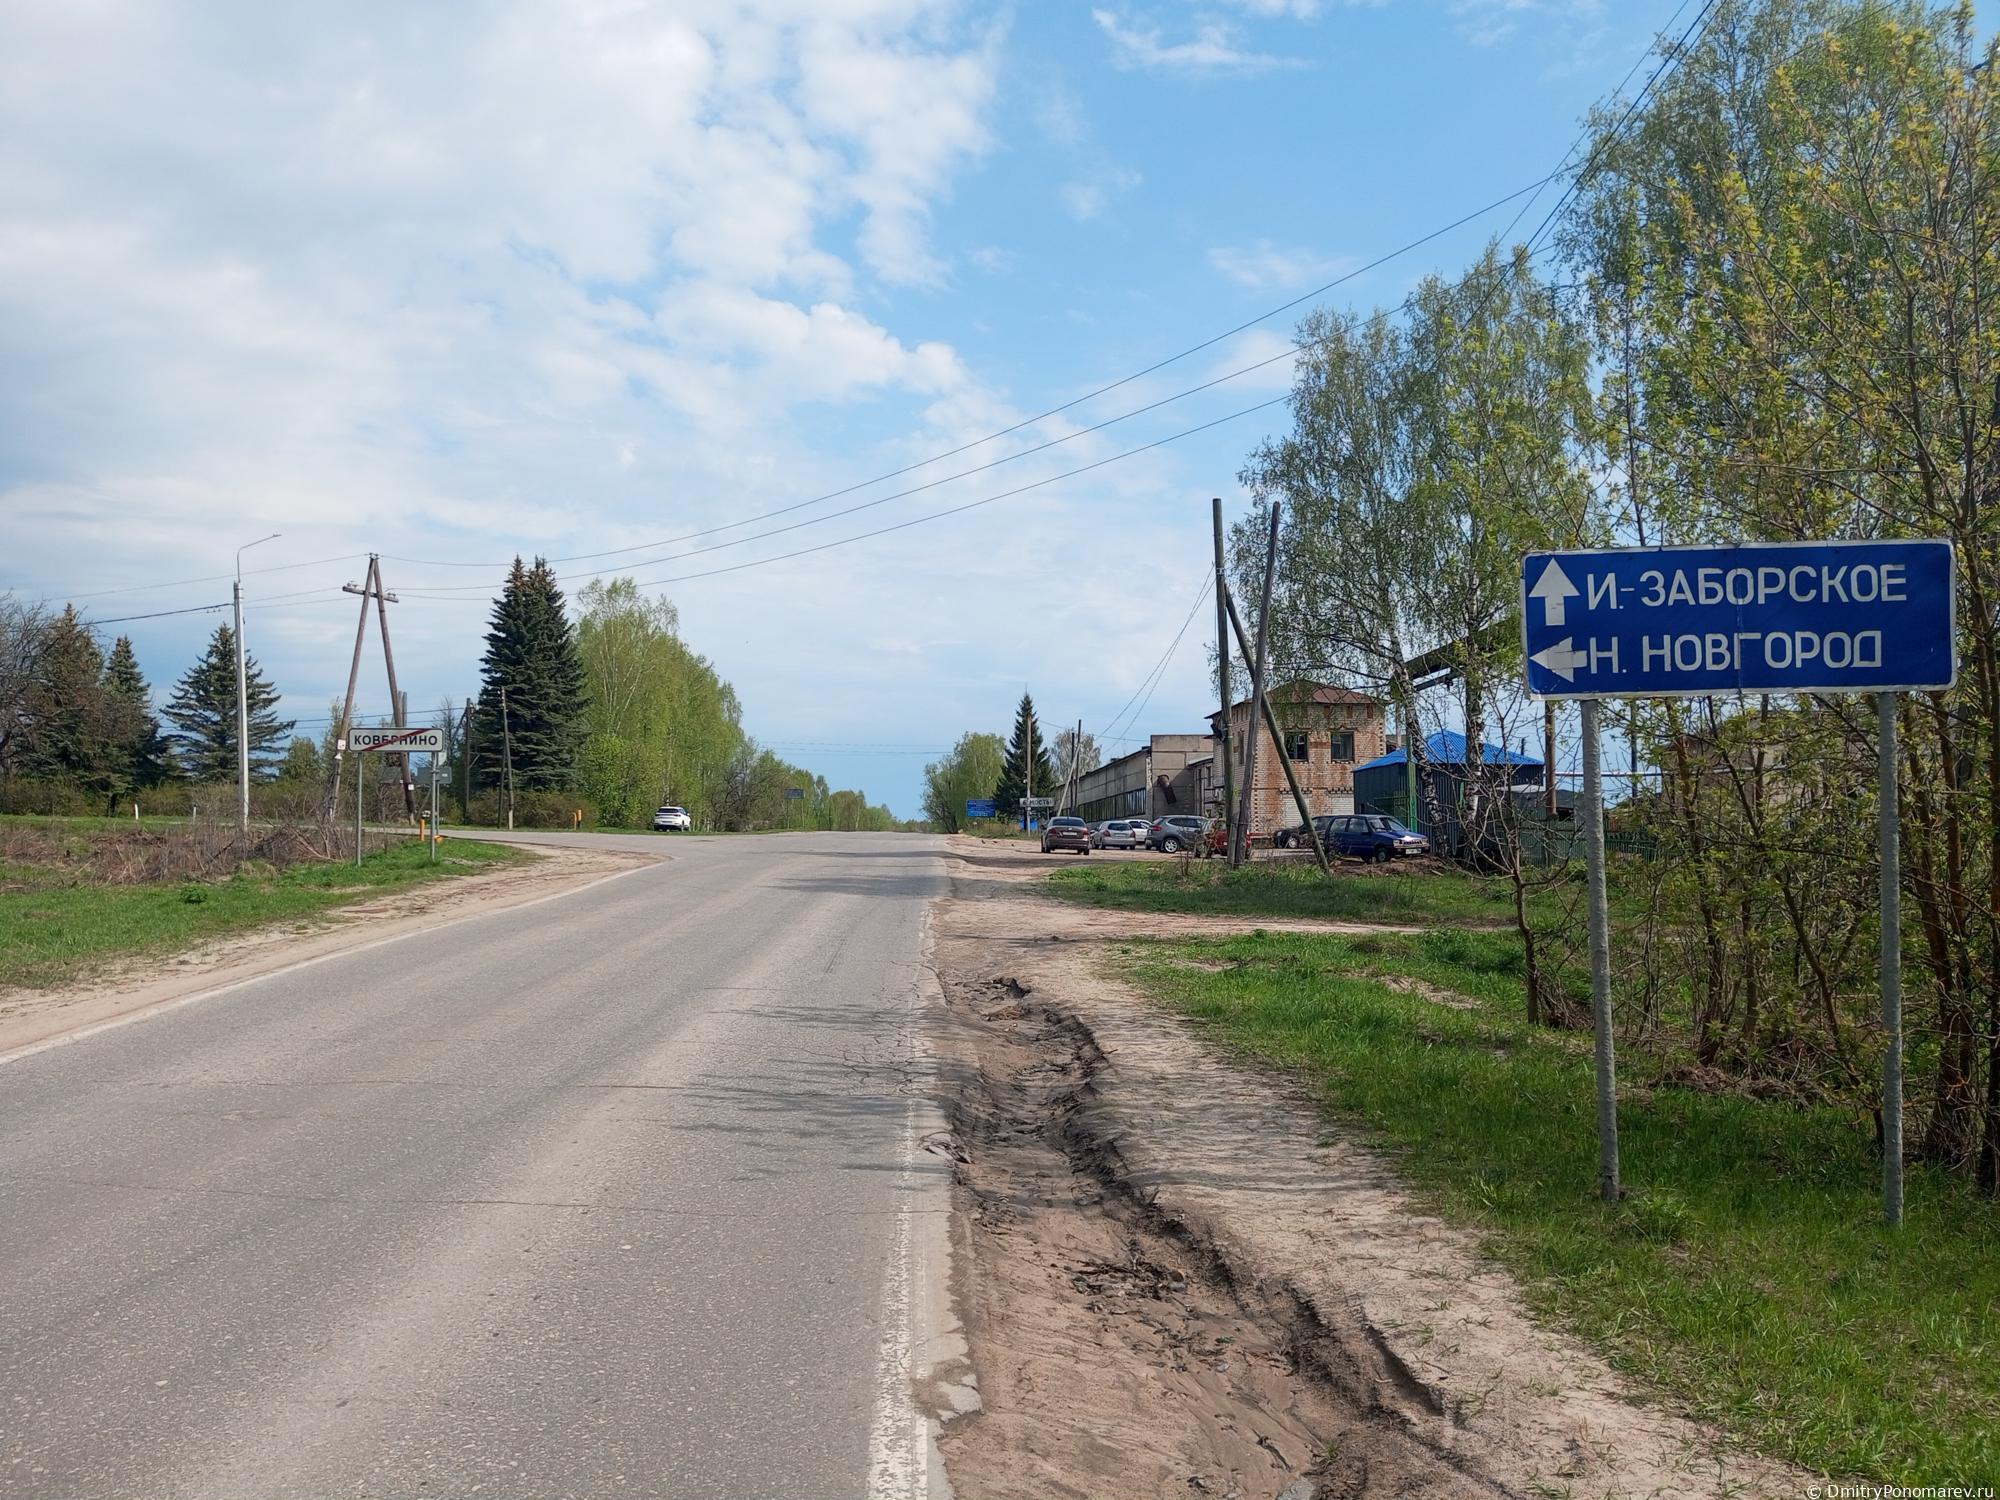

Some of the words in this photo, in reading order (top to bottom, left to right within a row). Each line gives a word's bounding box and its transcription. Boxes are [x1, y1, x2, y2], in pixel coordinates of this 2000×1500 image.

[1587, 564, 1907, 610] И.-ЗАБОРСКОЕ
[1590, 636, 1627, 674] Н.
[1643, 630, 1882, 672] НОВГОРОД
[354, 735, 438, 746] КОВЕРНИНО
